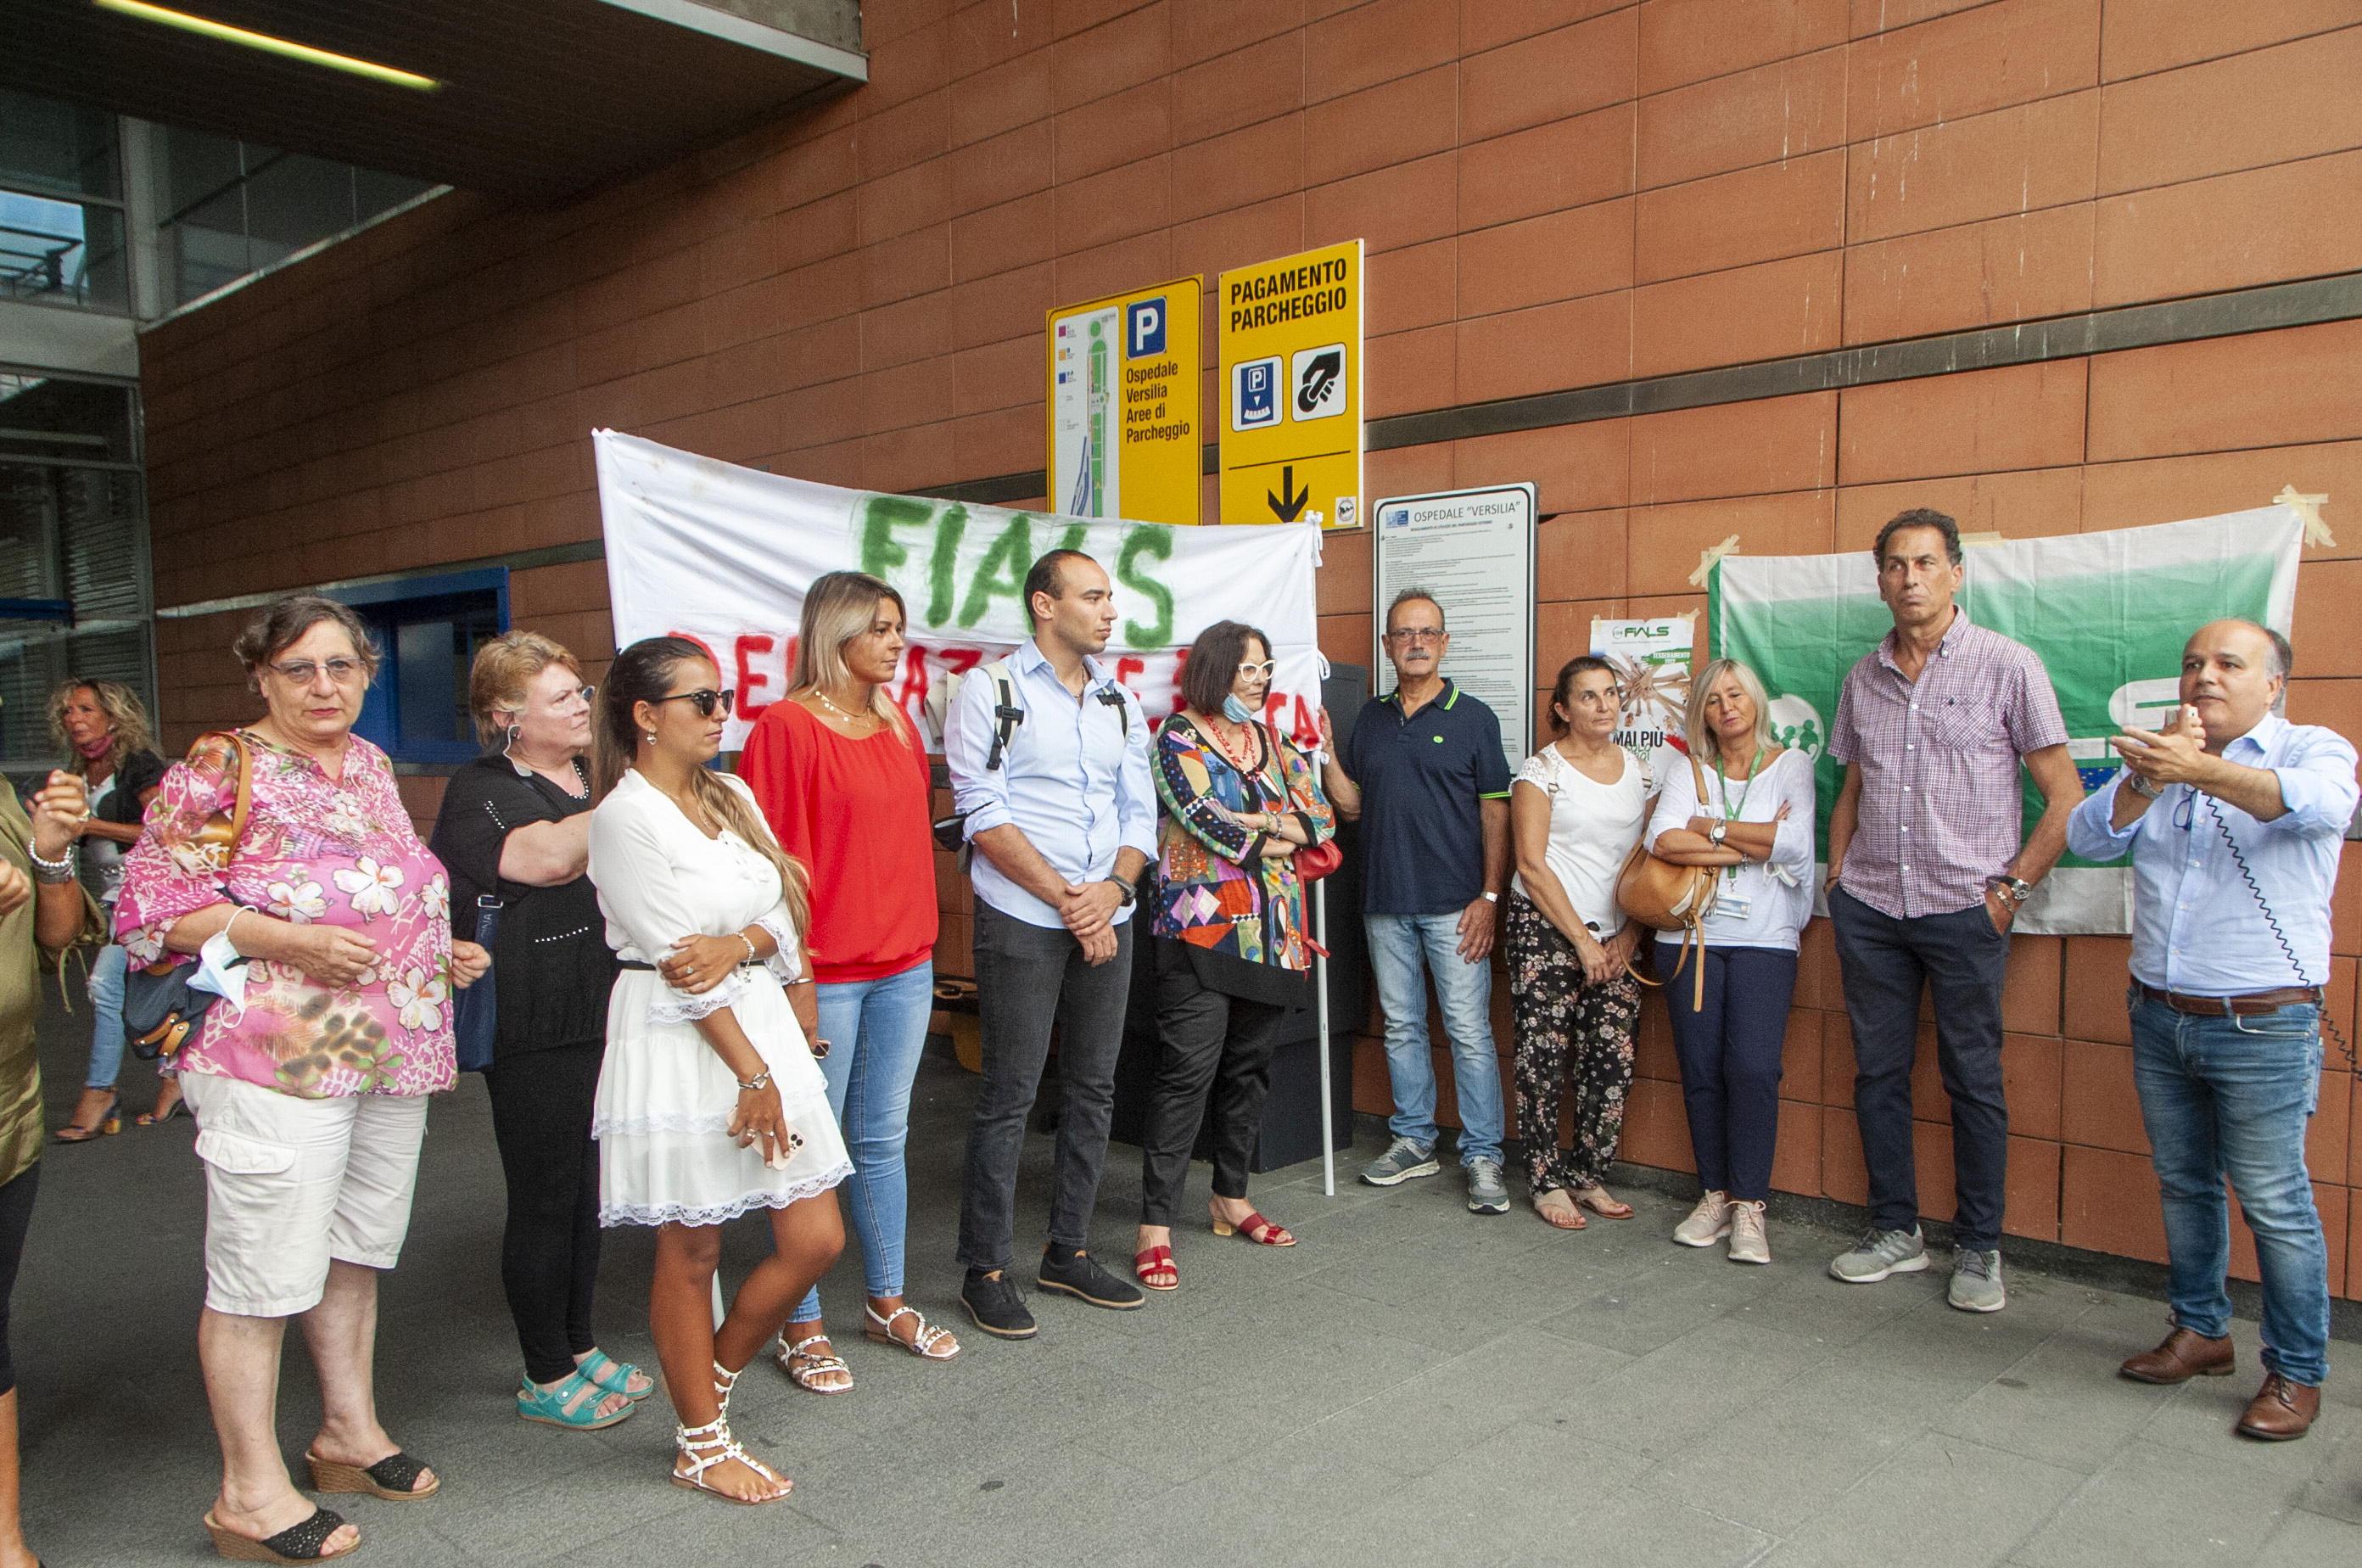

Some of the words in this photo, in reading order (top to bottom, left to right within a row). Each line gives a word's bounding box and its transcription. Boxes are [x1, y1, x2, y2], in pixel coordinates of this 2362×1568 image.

[1231, 258, 1346, 305] PAGAMENTO
[1231, 287, 1346, 333] PARCHEGGIO
[1136, 307, 1159, 351] P
[1127, 361, 1178, 384] Ospedale
[1252, 371, 1262, 389] P
[1127, 384, 1168, 403] Versilia
[1127, 407, 1151, 423] Aree
[1156, 402, 1166, 419] di
[1127, 420, 1190, 444] Parcheggio
[1413, 507, 1464, 523] OSPEDALE
[862, 497, 1173, 649] FIAS
[1625, 626, 1670, 638] FIALS
[1613, 731, 1637, 747] MAI
[1641, 725, 1664, 748] PIÙ
